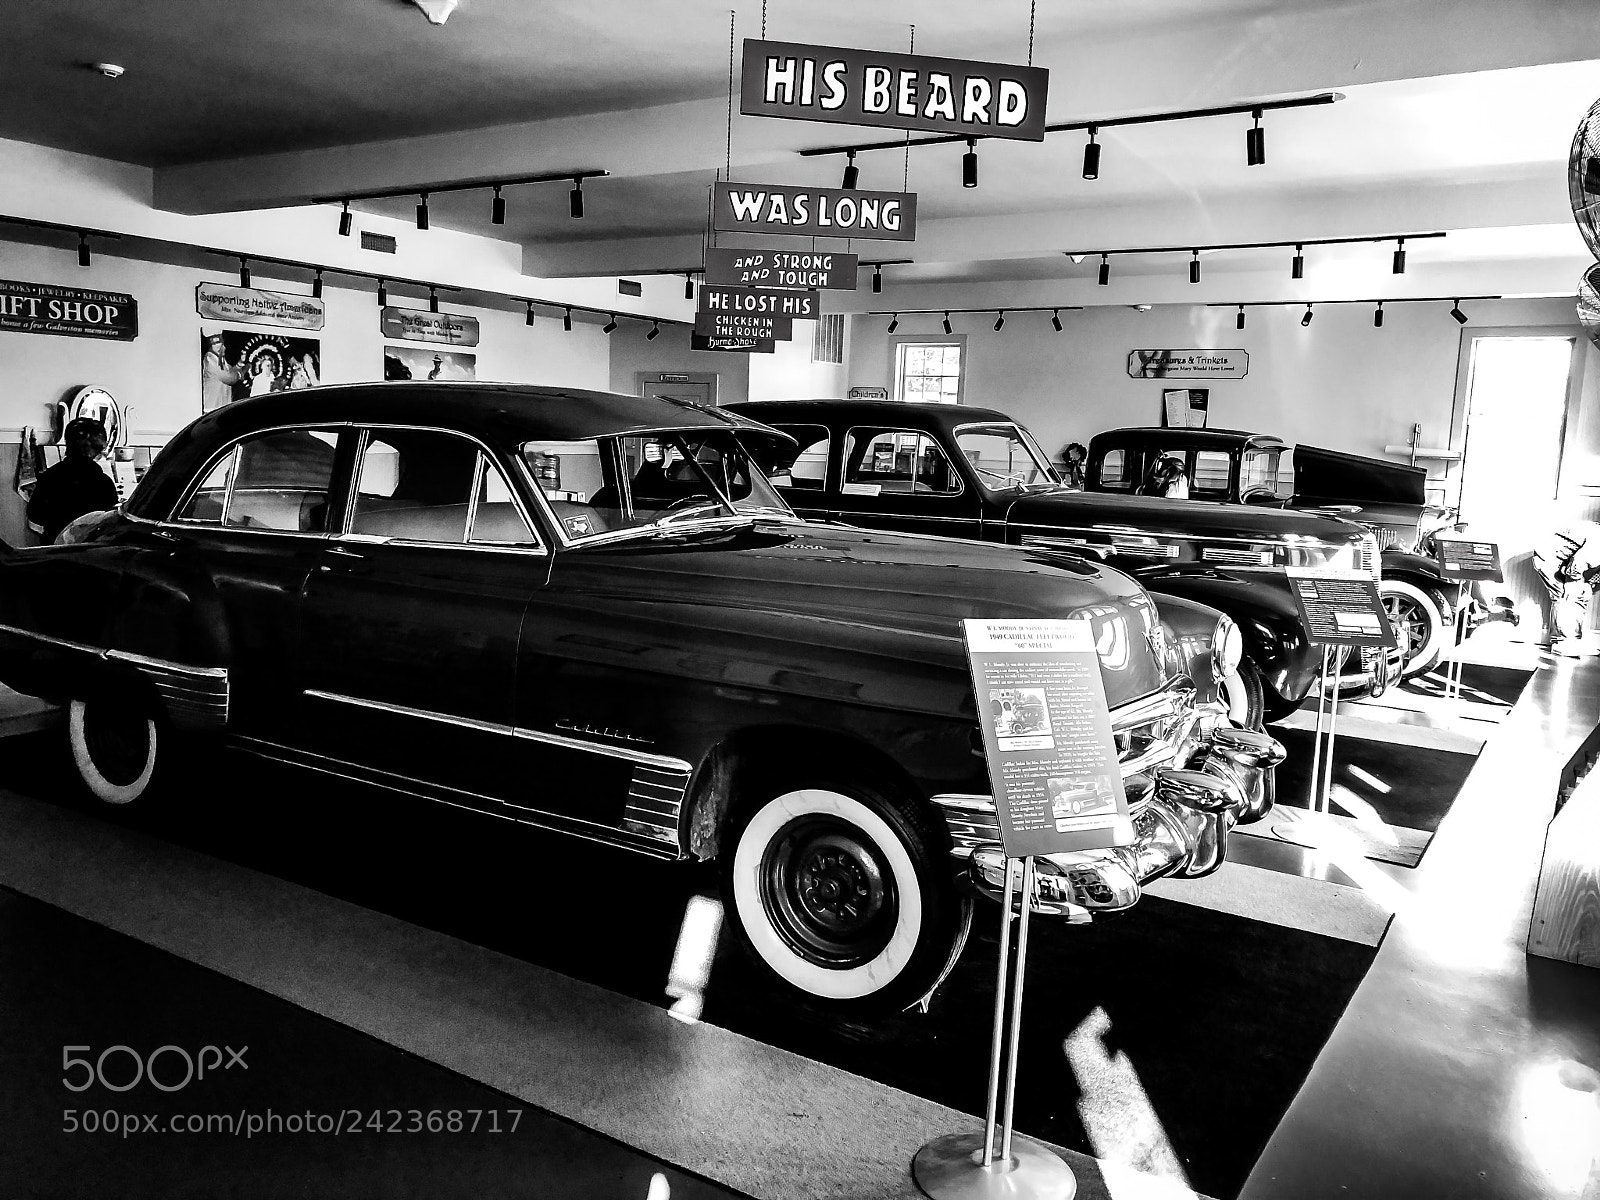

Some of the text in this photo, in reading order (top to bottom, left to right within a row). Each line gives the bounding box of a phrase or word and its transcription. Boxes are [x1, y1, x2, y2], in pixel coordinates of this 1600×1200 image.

[764, 56, 1028, 127] HIS BEARD
[728, 191, 901, 230] WAS LONG
[734, 253, 832, 270] AND STRONG
[741, 268, 828, 286] AND TOUGH
[38, 287, 76, 298] JEWELRY
[83, 292, 128, 304] KEEPSAKES
[199, 290, 322, 316] Supporting Native Americans
[708, 292, 811, 315] HE LOST HIS
[48, 299, 119, 325] SHOP
[45, 322, 82, 333] Galveston
[715, 315, 773, 327] CHICKEN IN
[715, 326, 772, 338] THE ROUGH
[1188, 356, 1195, 365] &
[1196, 356, 1229, 365] Trinkets
[1003, 633, 1034, 641] CADILLAC
